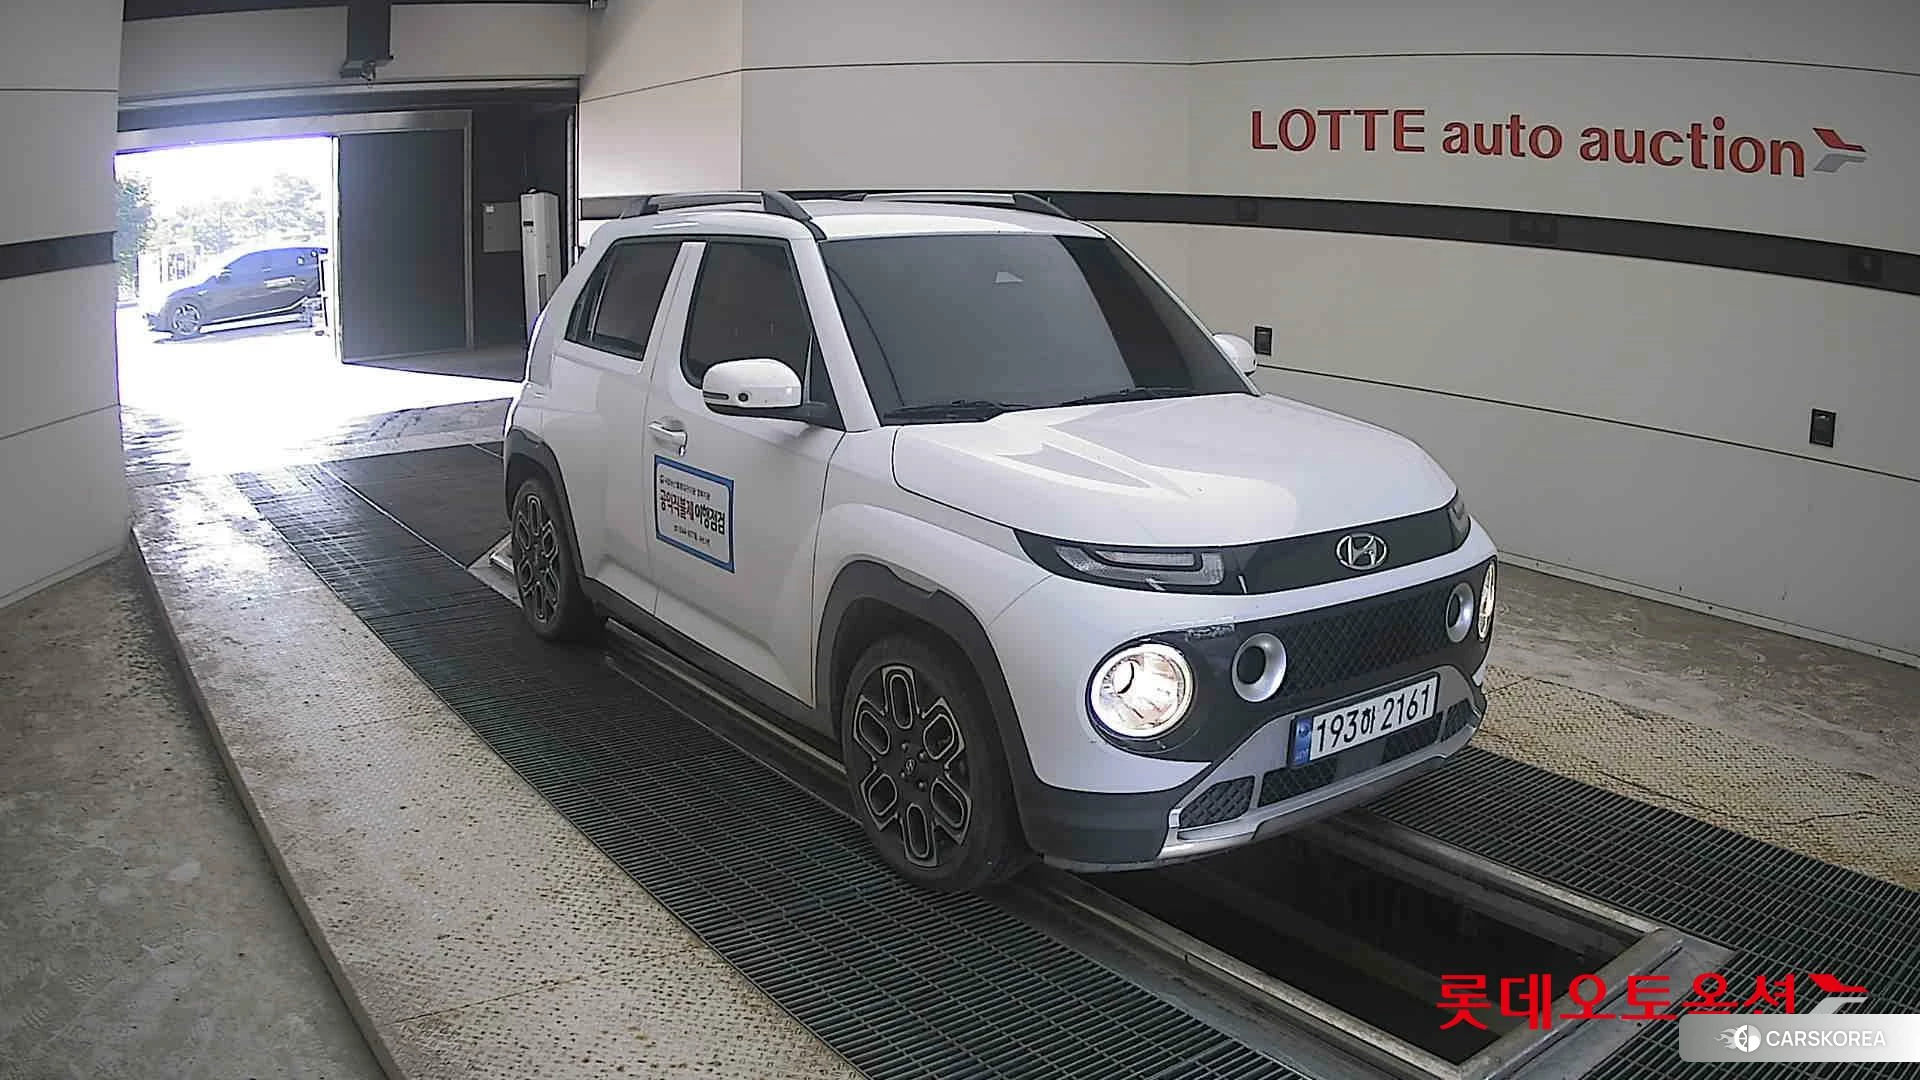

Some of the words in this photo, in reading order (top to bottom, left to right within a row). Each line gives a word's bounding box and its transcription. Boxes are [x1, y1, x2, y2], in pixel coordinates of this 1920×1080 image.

[1252, 108, 1427, 153] LOTTE
[1441, 114, 1564, 160] auto
[1580, 116, 1806, 178] auction
[1316, 705, 1376, 753] 193하
[1380, 684, 1431, 731] 2161
